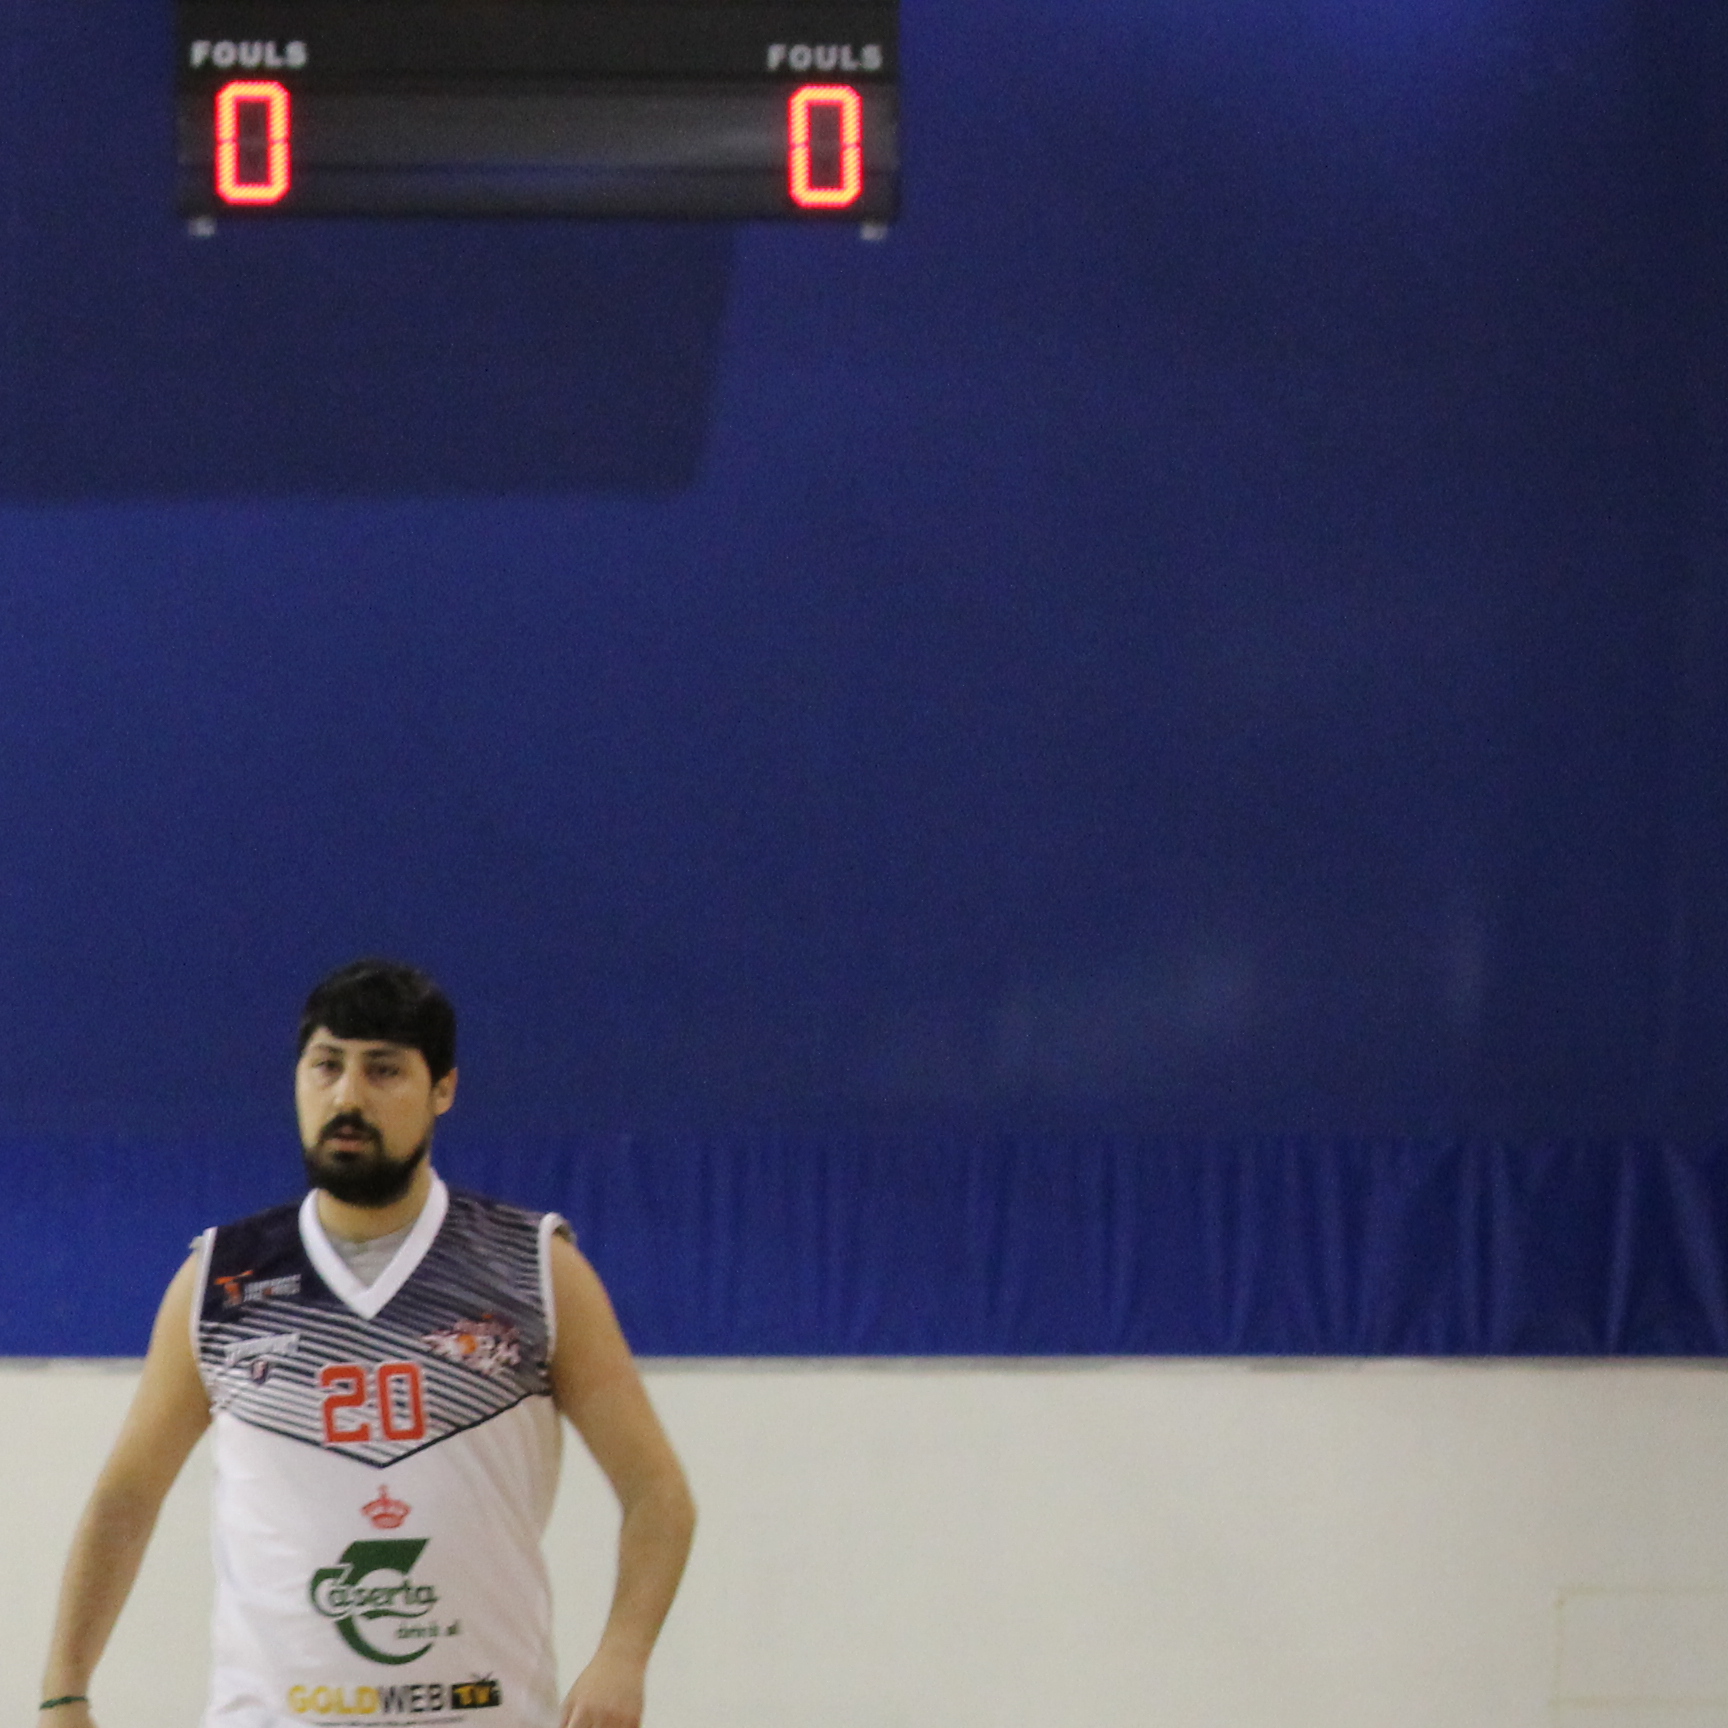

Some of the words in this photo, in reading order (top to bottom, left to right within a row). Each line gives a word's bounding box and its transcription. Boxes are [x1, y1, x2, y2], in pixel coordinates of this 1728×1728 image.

[191, 41, 307, 67] FOULS
[767, 44, 883, 70] FOULS
[215, 80, 291, 204] 0
[787, 85, 862, 208] 0
[319, 1363, 427, 1443] 20
